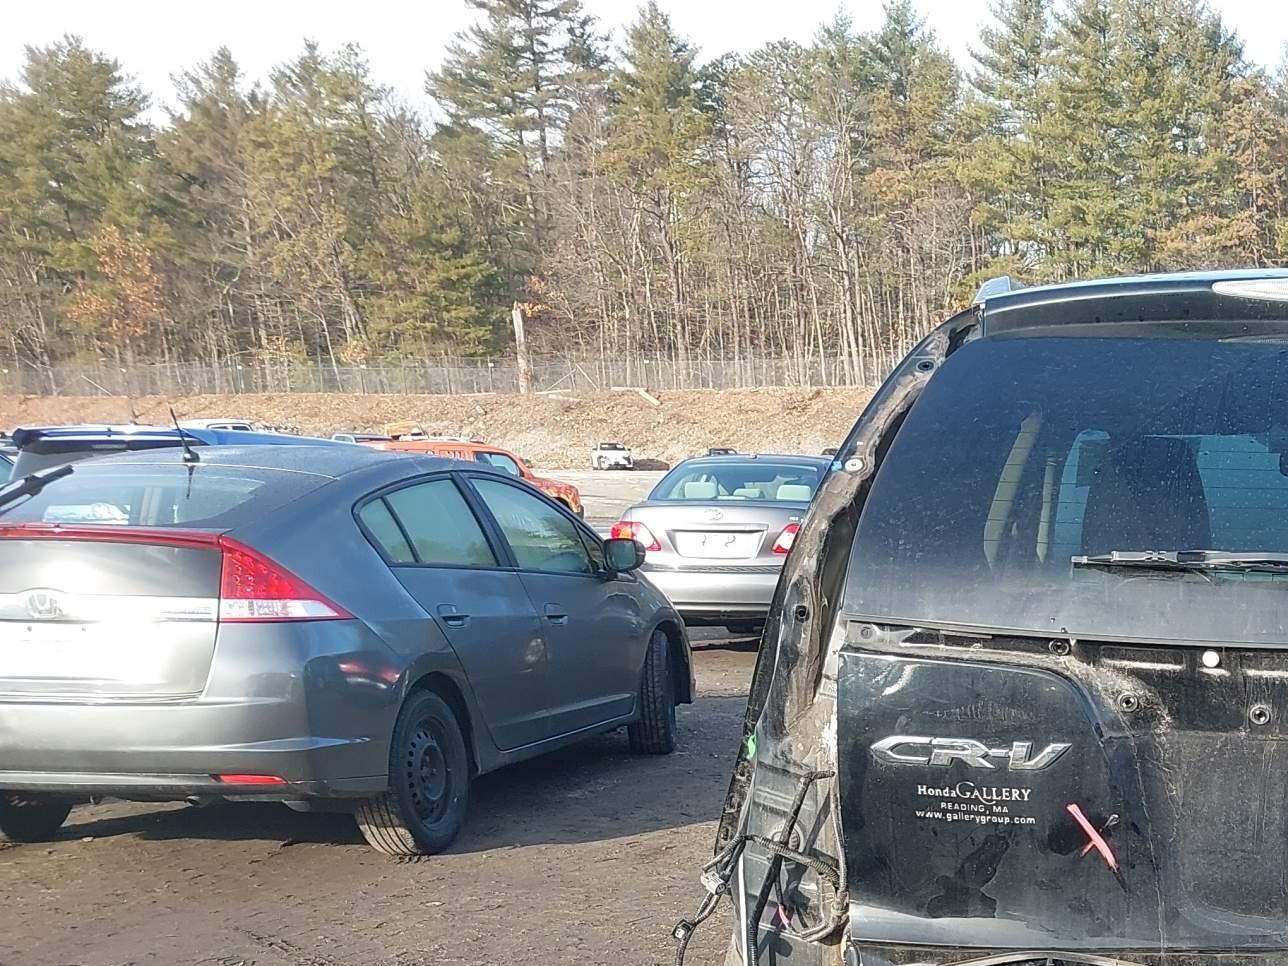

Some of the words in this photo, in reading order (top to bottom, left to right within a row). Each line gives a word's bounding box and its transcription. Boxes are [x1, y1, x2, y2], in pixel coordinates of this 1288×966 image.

[870, 735, 1072, 771] CR-V
[992, 805, 1009, 813] MA
[915, 810, 1036, 825] www.gallerygroup.com
